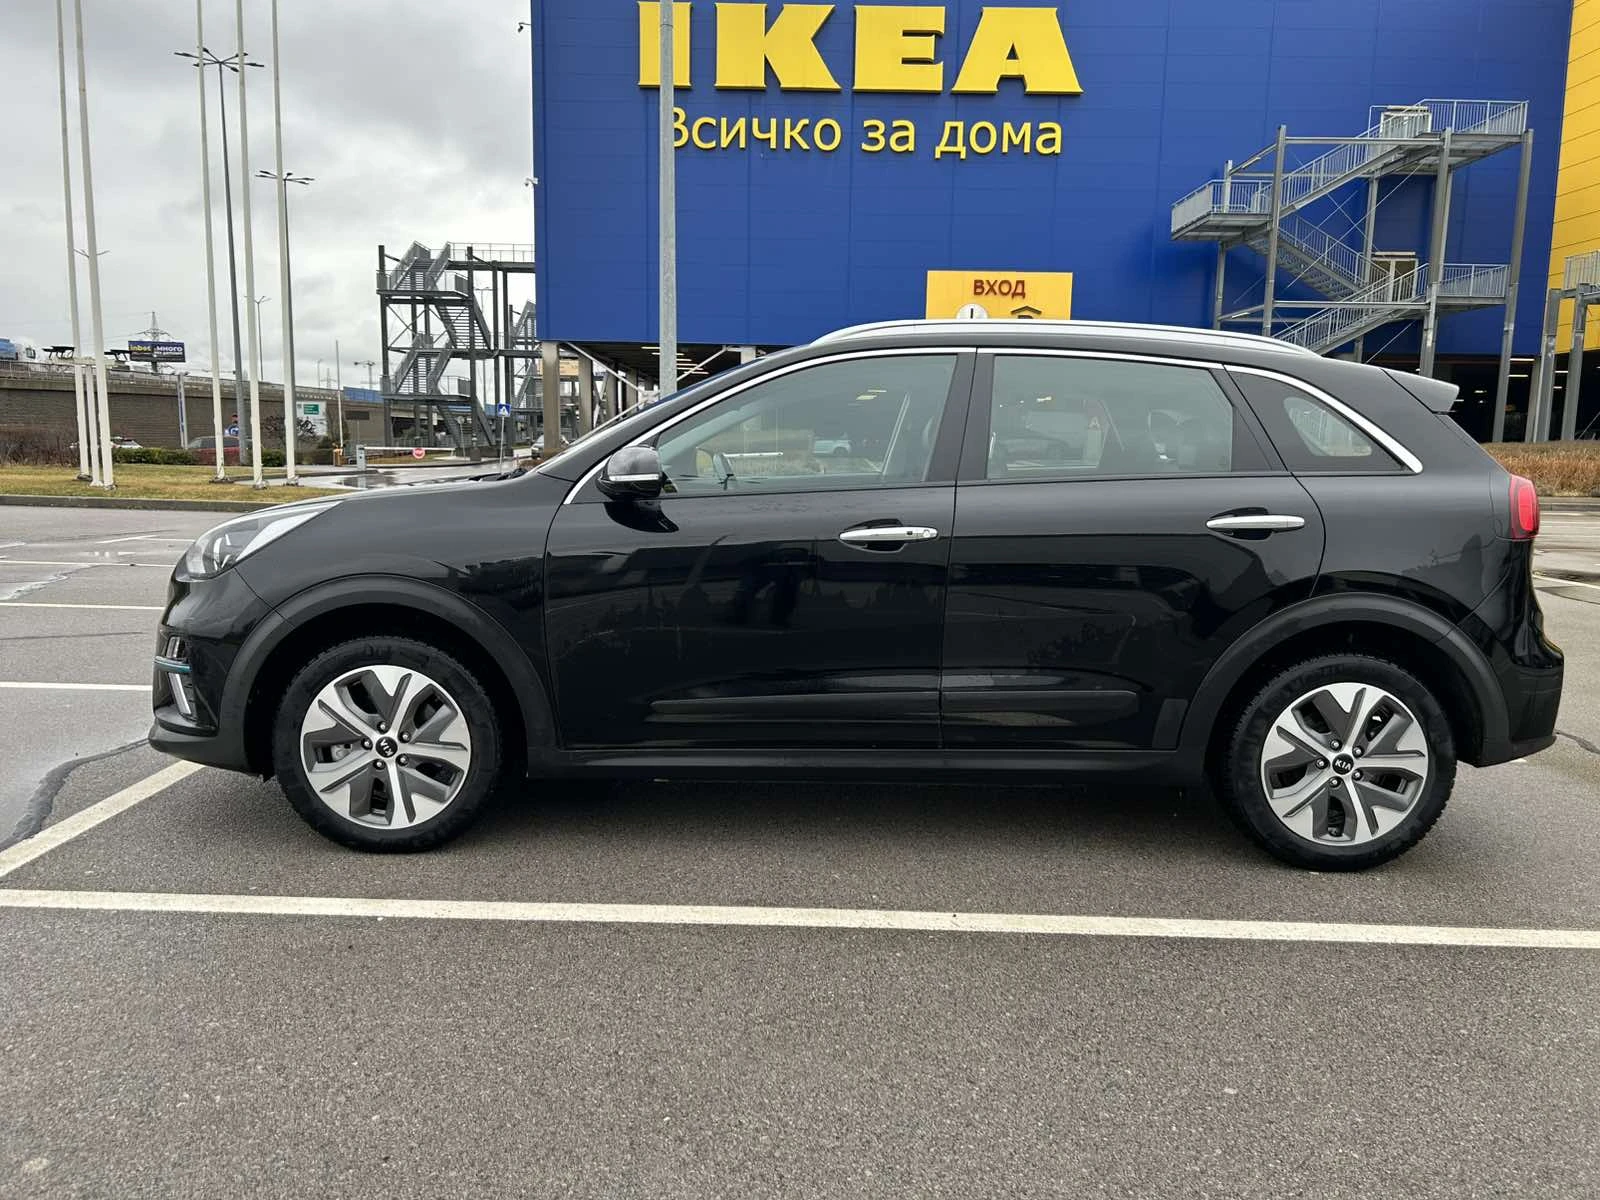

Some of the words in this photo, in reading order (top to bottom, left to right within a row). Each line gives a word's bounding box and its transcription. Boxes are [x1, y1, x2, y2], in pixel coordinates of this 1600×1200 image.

[638, 1, 1084, 95] IKEA
[861, 118, 916, 153] за
[934, 119, 1063, 160] дома
[973, 279, 1026, 299] ВХОД
[1335, 759, 1351, 770] KIA
